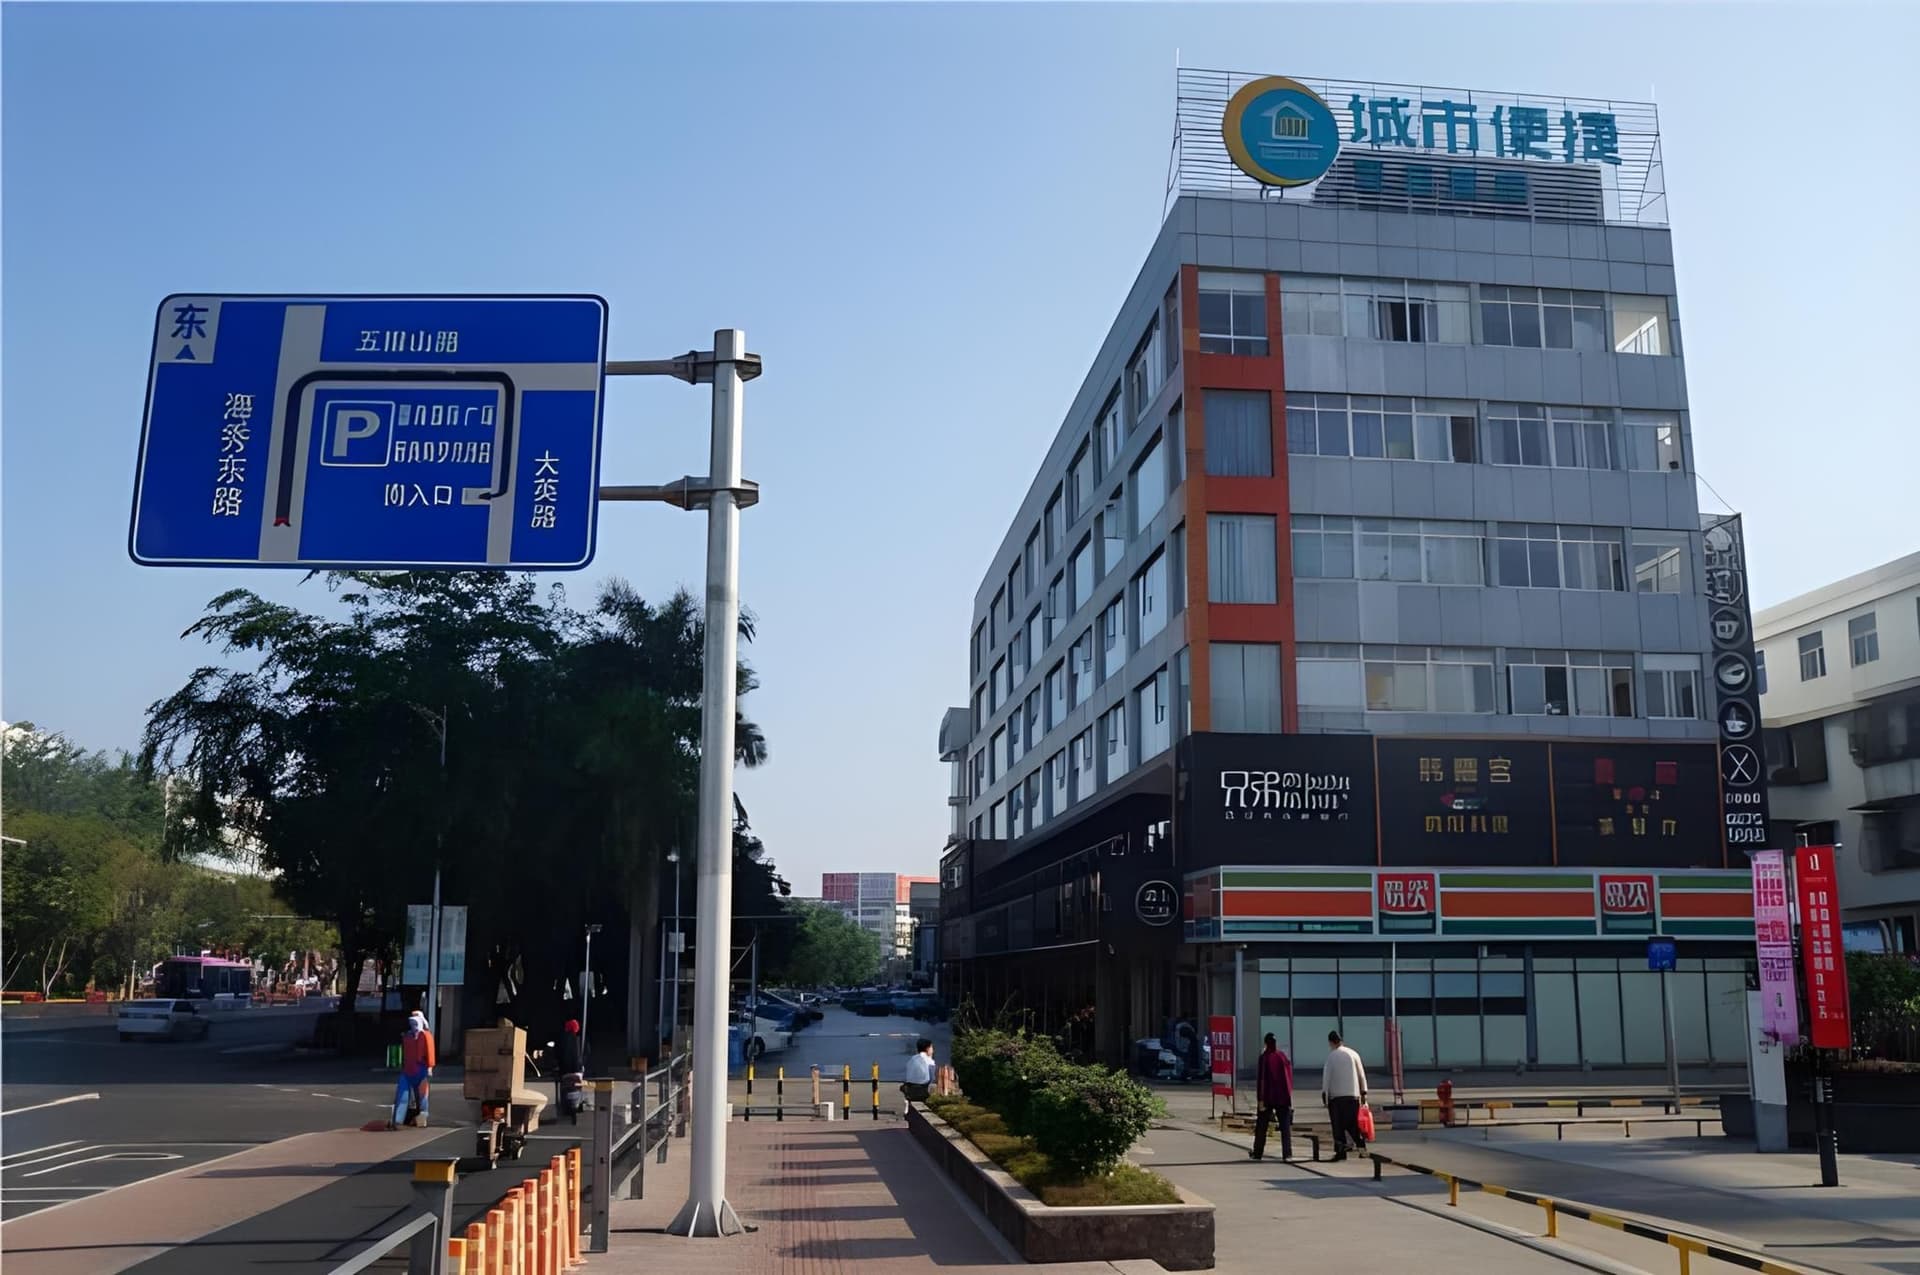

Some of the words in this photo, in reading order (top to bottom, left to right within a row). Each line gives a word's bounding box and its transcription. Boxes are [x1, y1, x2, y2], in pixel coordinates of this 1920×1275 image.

[1348, 94, 1622, 165] 城市便捷
[171, 303, 209, 339] 东
[332, 409, 381, 457] P
